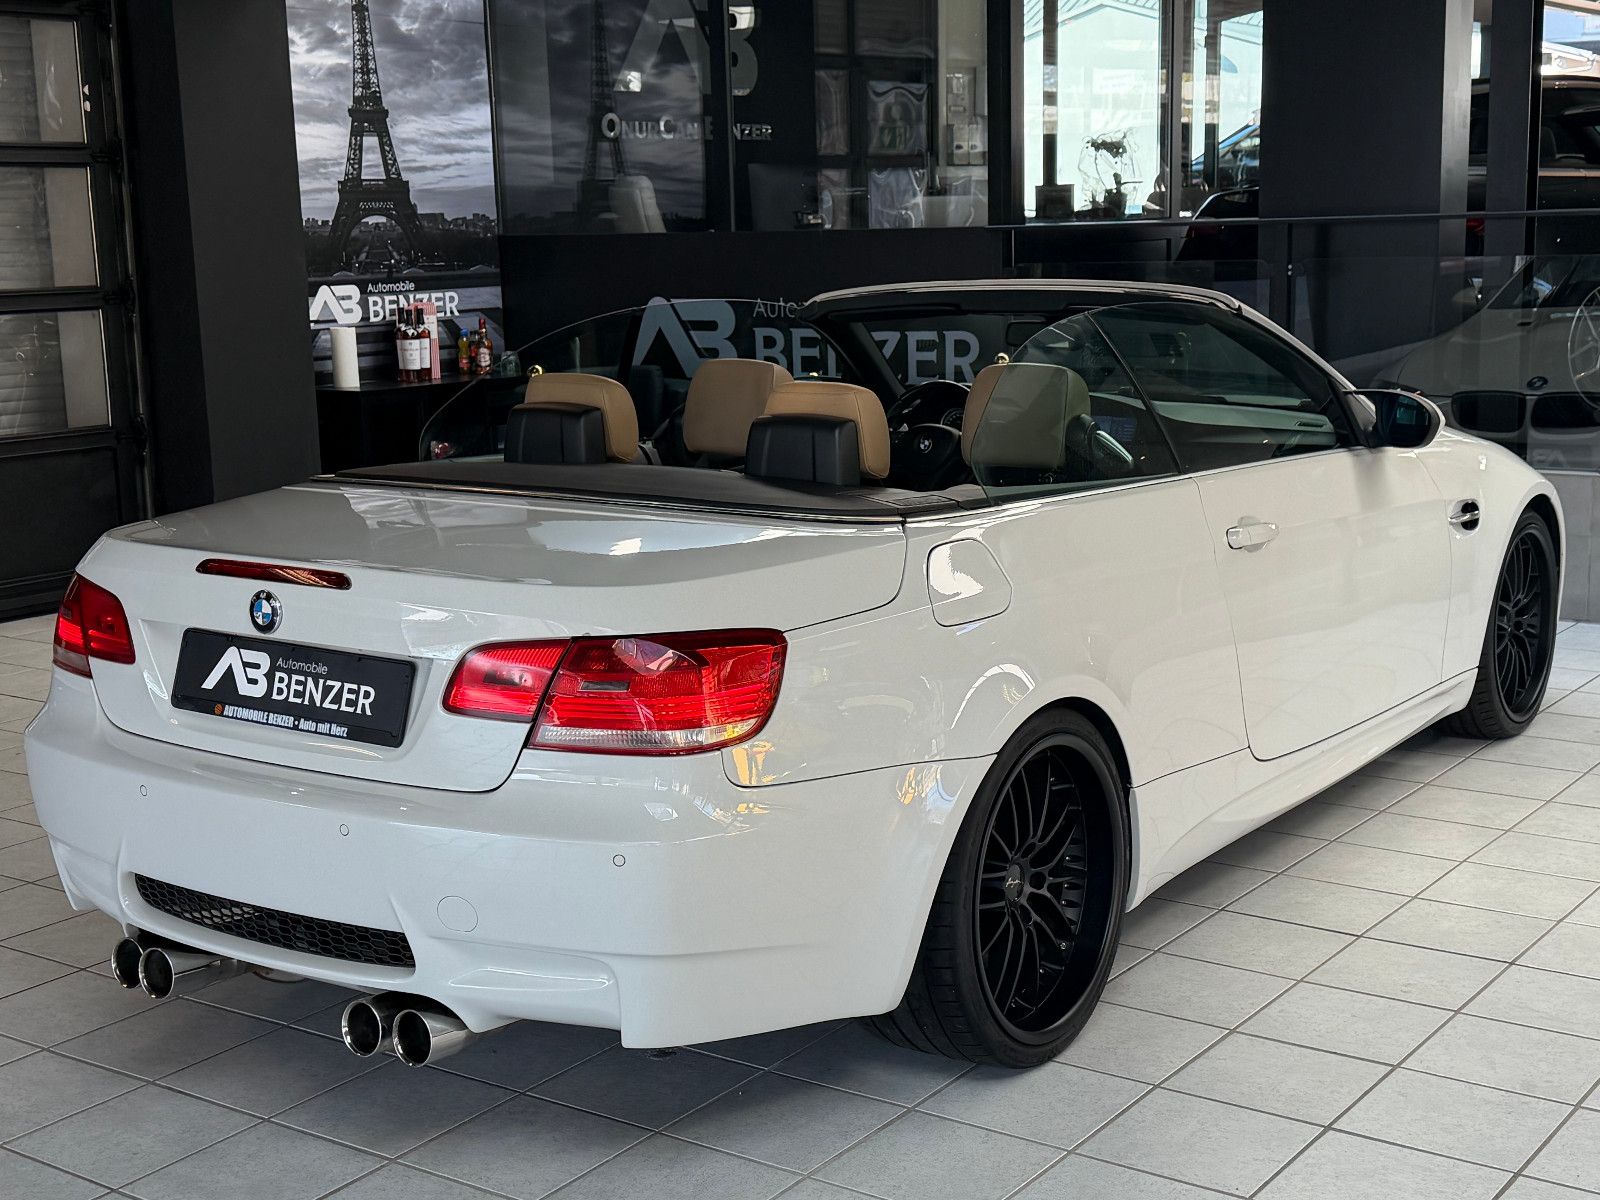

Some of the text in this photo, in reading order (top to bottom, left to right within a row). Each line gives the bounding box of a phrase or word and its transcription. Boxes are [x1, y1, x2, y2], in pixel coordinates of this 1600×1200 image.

[367, 281, 415, 293] Automobile
[276, 656, 328, 675] Automobile
[272, 671, 376, 716] BENZER
[223, 703, 348, 738] AUTOMOBILE BENZER Auto mit Herz
